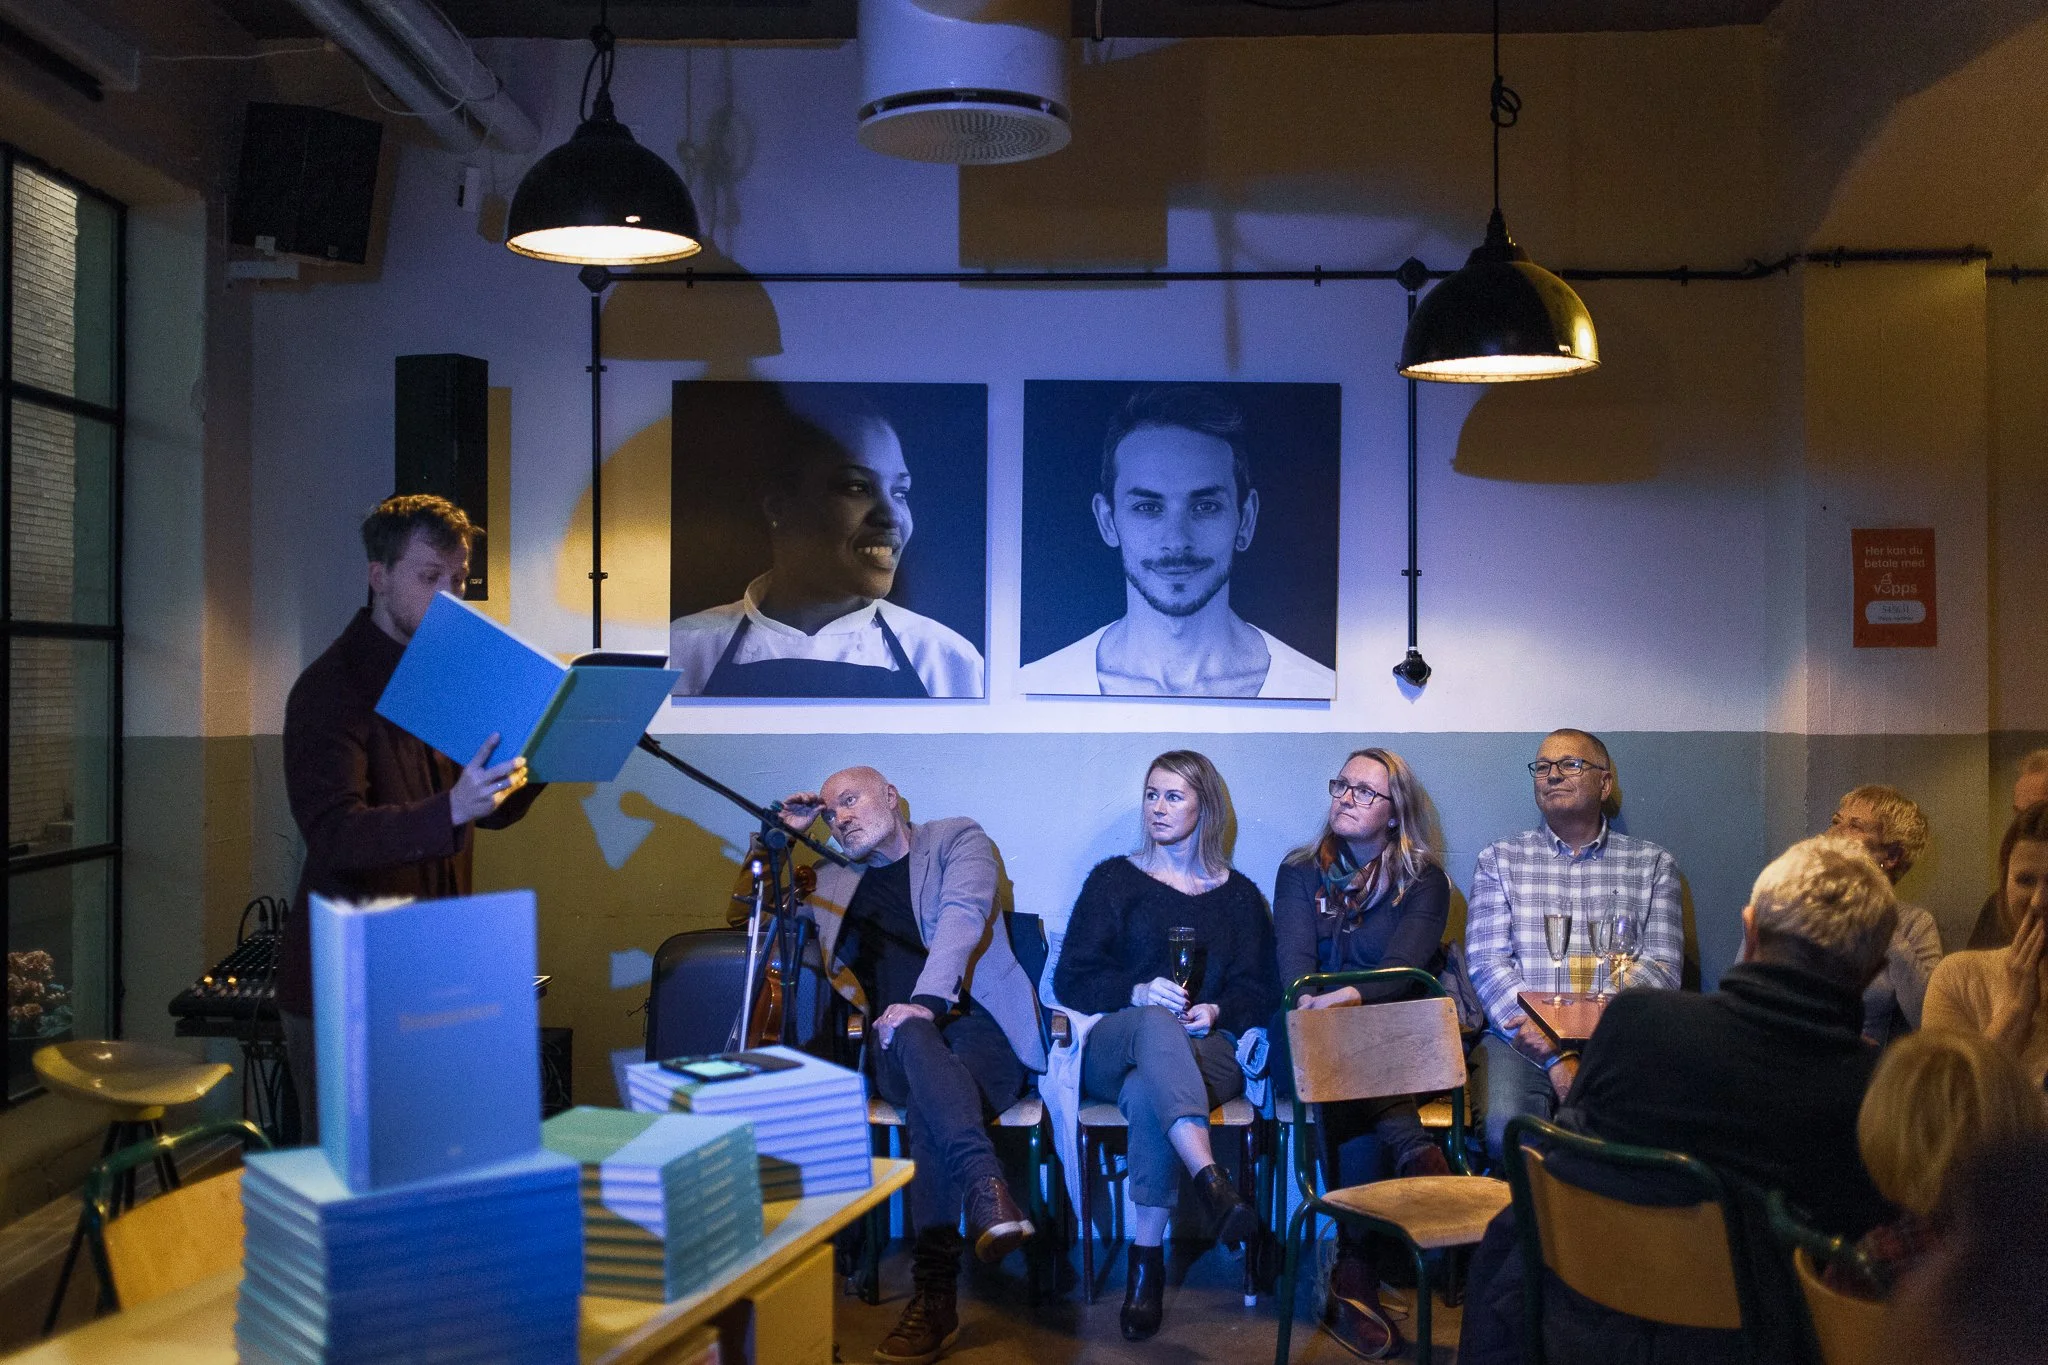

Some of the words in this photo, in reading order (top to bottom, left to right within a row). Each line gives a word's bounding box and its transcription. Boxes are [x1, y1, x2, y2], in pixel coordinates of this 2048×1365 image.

[1865, 545, 1883, 556] Her
[1886, 545, 1906, 555] kan
[1909, 545, 1923, 555] du
[1864, 558, 1898, 568] betale
[1901, 558, 1925, 568] med
